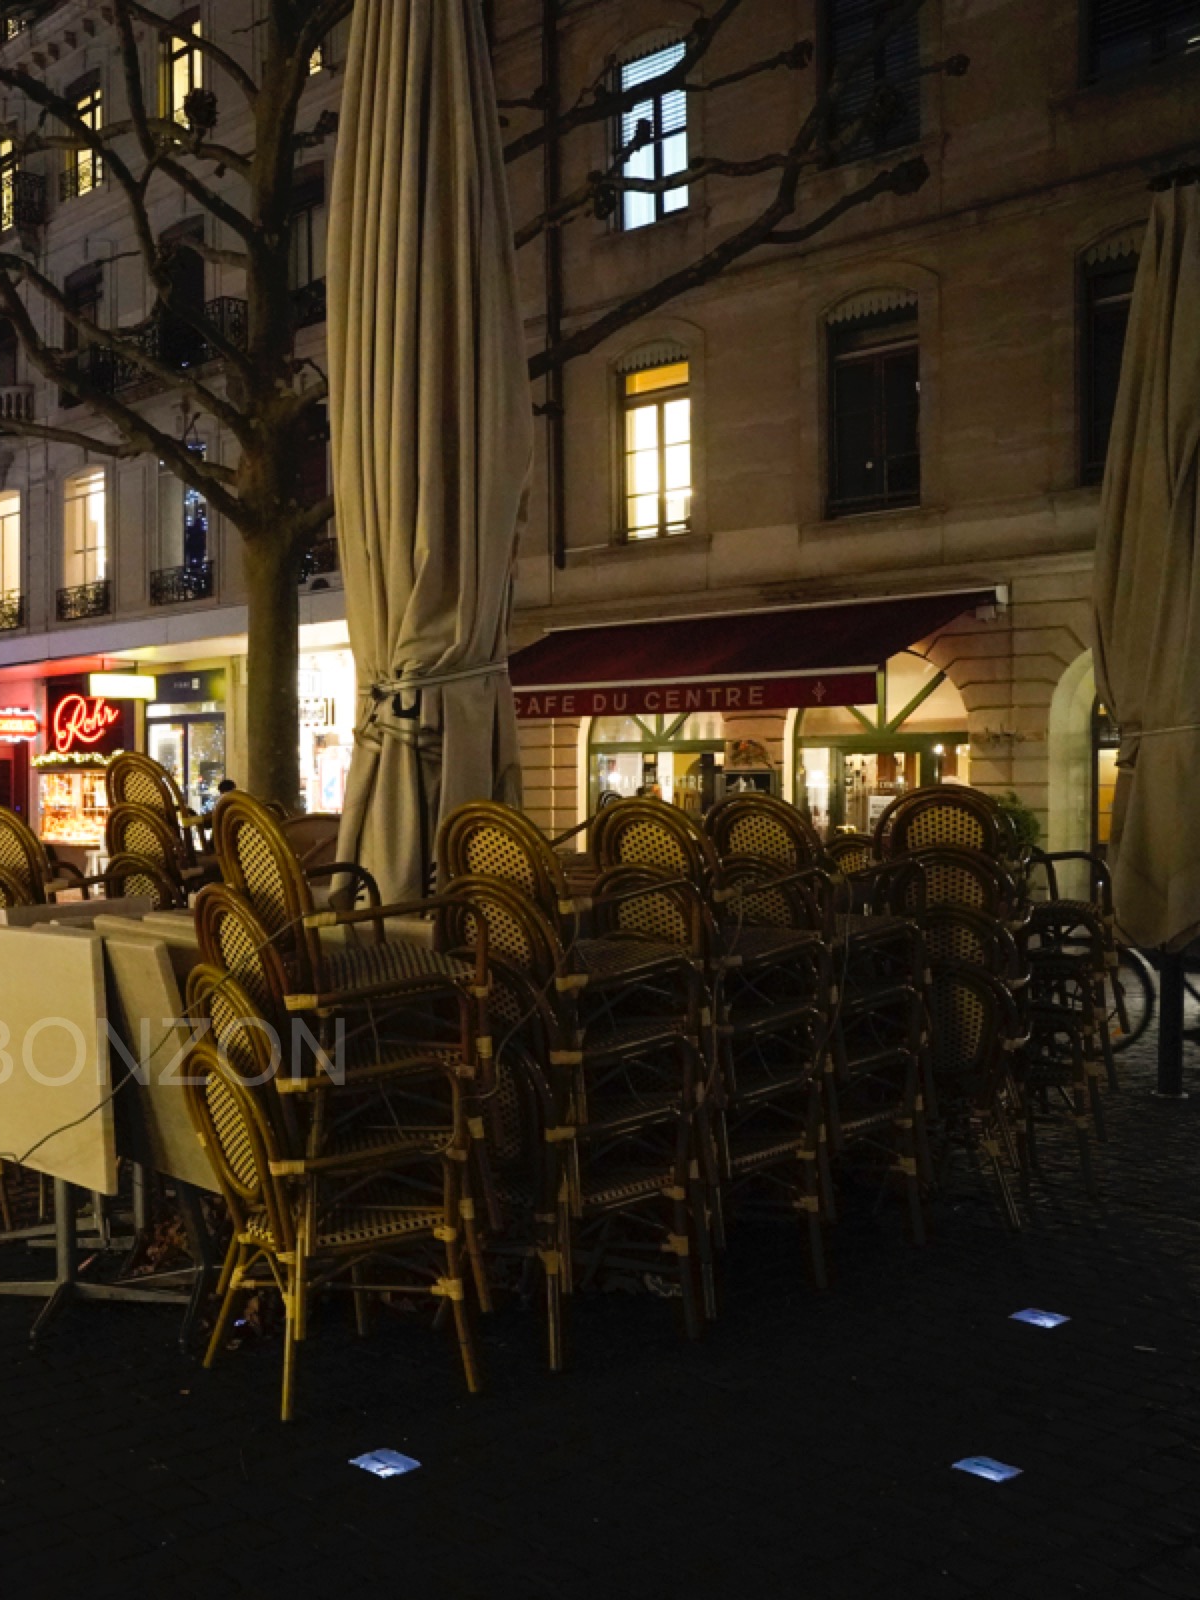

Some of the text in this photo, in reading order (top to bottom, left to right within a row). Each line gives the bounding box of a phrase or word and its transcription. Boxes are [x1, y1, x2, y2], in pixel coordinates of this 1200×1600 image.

[593, 693, 628, 712] DU
[644, 685, 765, 711] CENTRE
[54, 694, 119, 753] Rohr
